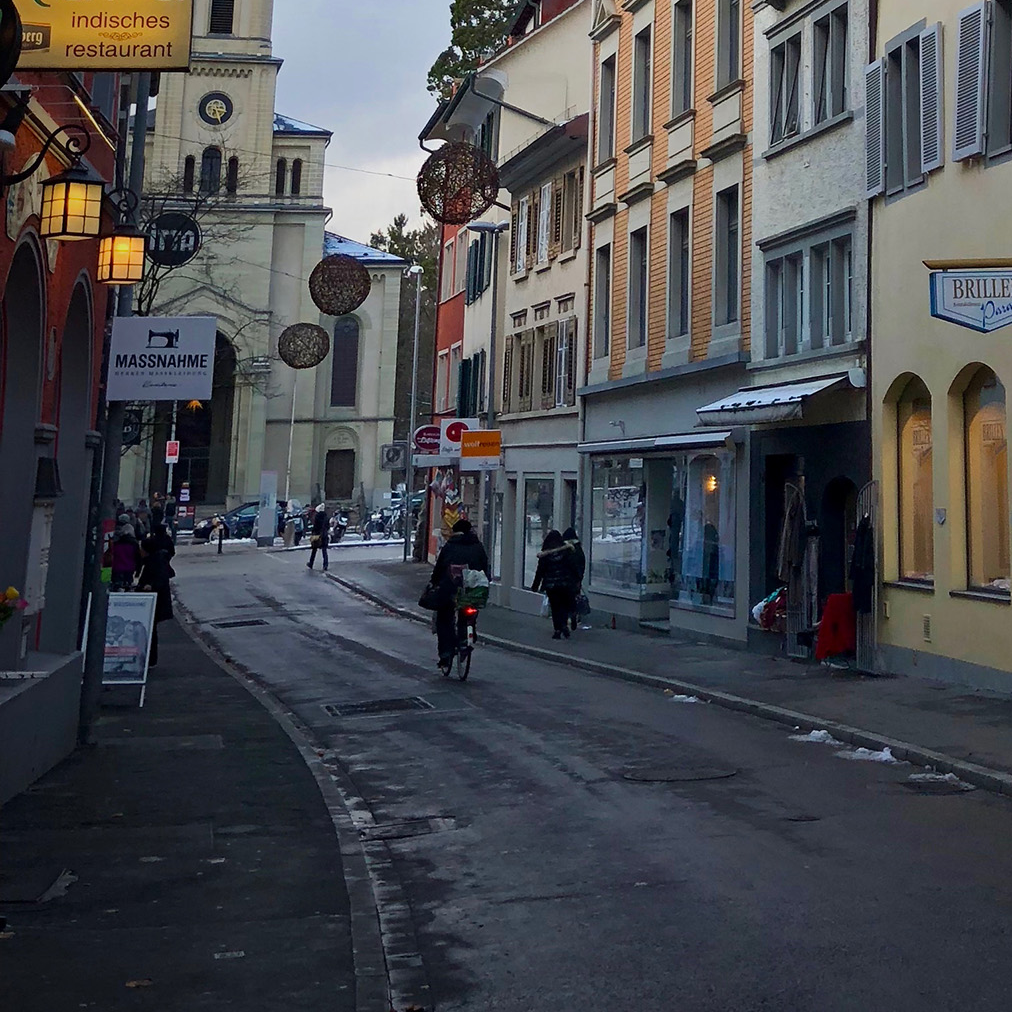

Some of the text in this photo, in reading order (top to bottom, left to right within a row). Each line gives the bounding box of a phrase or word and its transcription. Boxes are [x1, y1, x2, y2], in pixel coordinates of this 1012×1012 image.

[71, 11, 170, 29] indisches
[65, 41, 173, 58] restaurant
[115, 354, 209, 369] MASSNAHME
